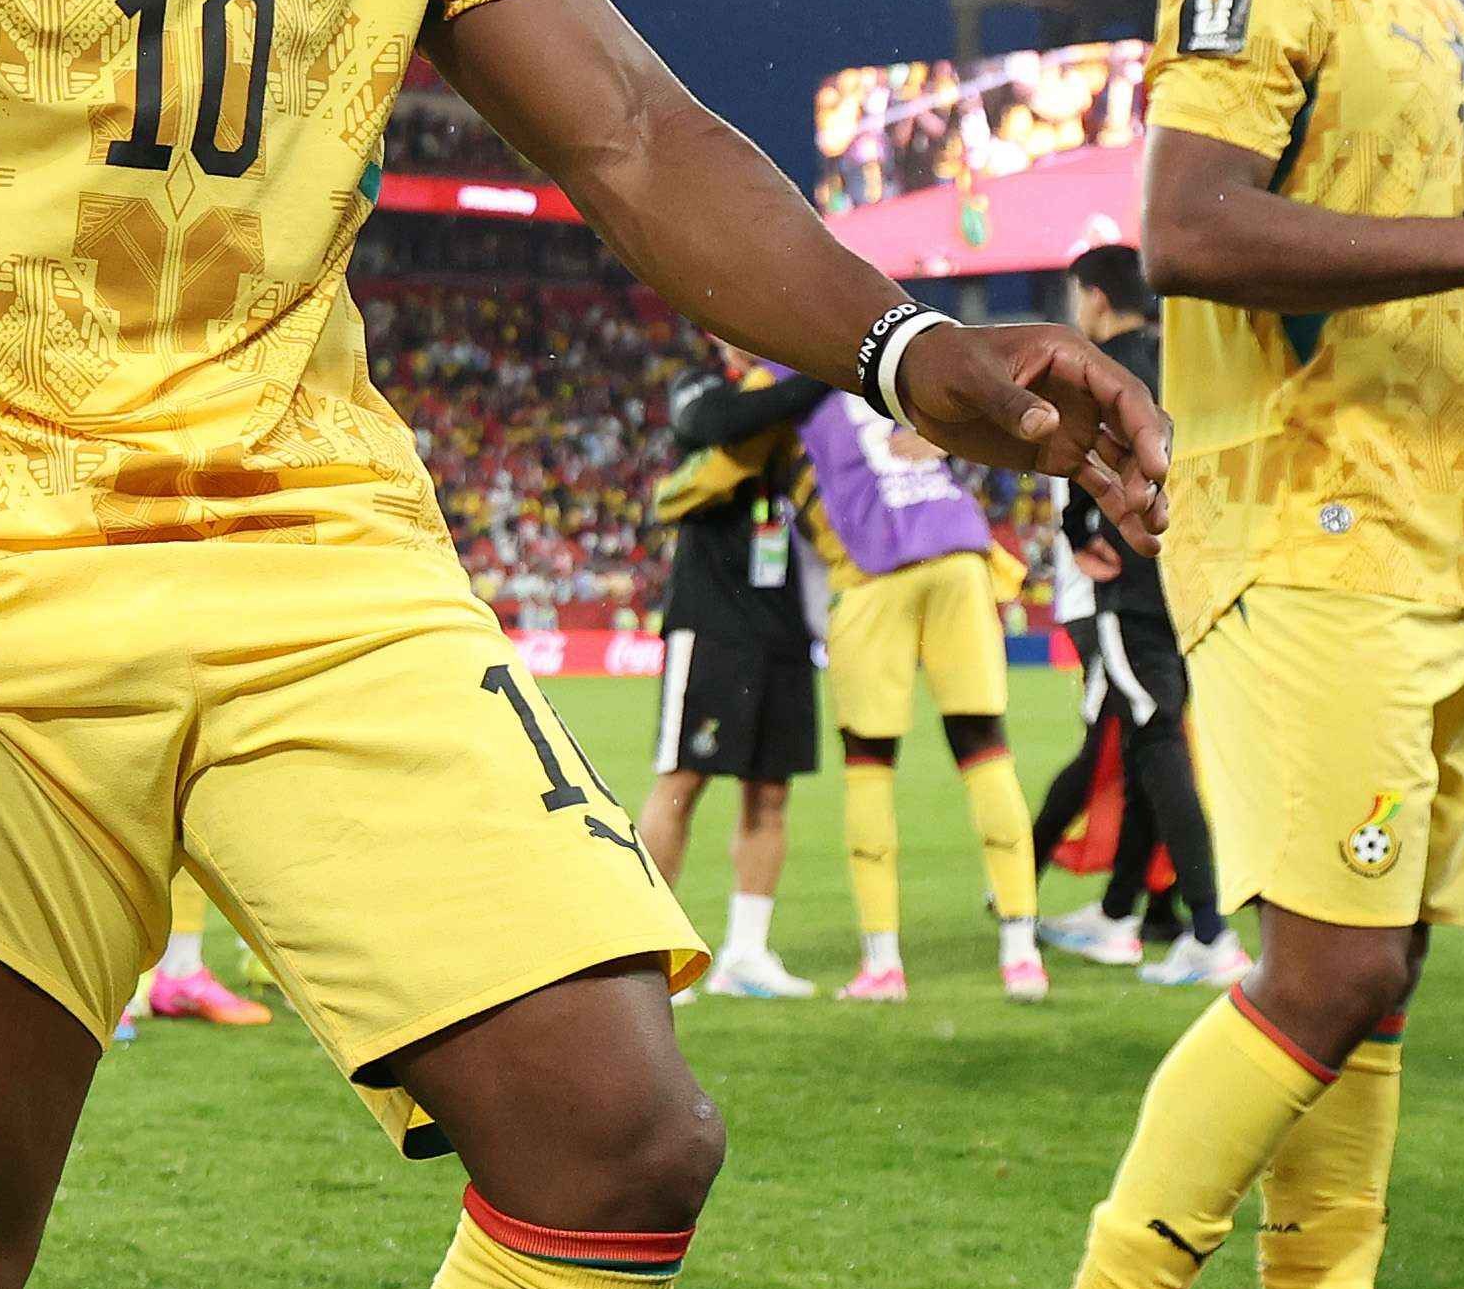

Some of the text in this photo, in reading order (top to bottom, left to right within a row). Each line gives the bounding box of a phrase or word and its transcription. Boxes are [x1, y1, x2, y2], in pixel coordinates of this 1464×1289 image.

[858, 337, 878, 363] IN
[872, 303, 918, 336] GOD
[480, 665, 609, 813] 1
